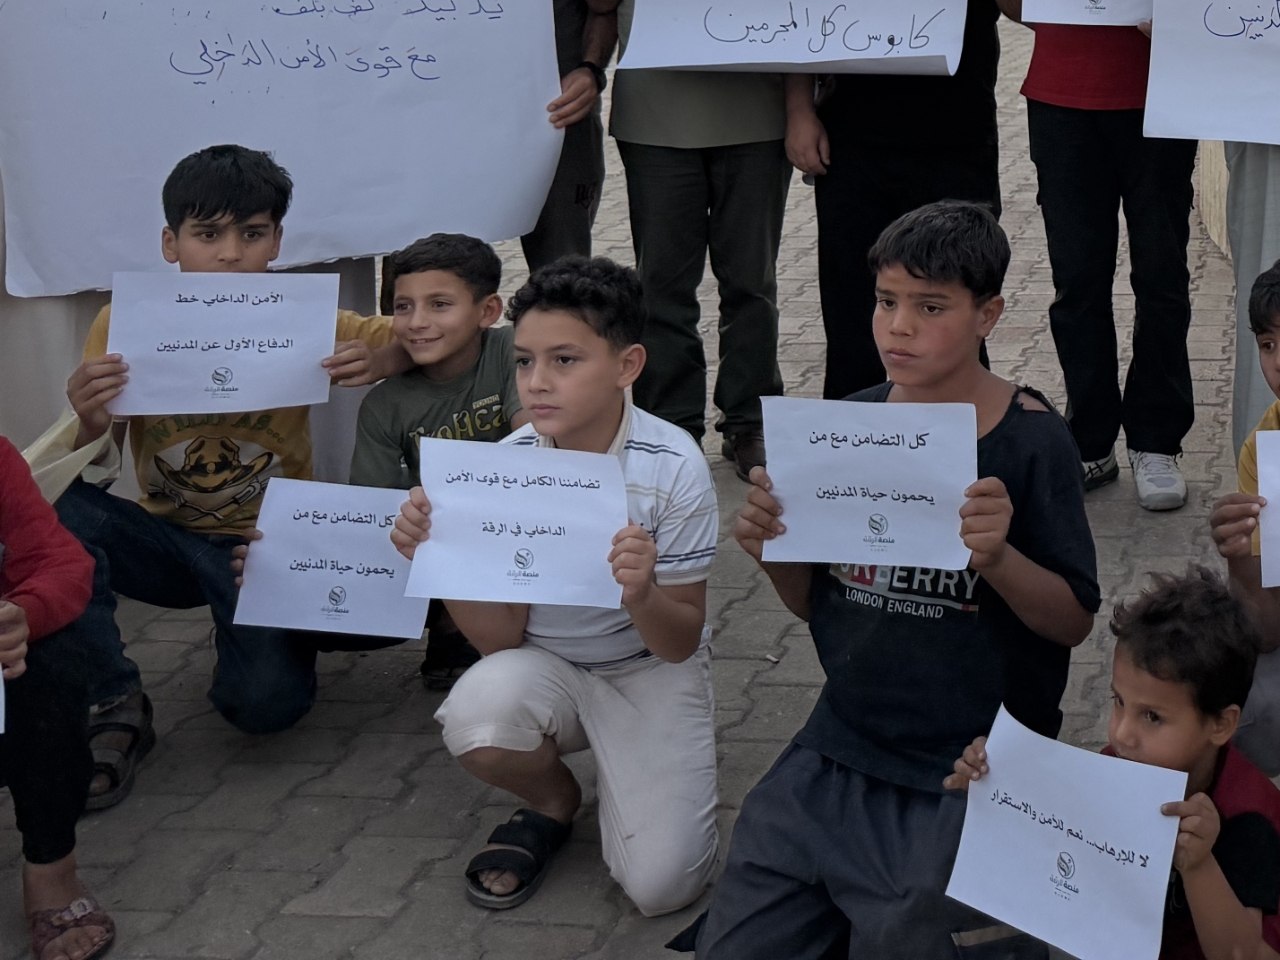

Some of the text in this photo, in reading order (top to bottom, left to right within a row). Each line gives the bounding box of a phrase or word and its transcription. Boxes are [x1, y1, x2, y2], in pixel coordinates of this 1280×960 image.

[704, 1, 946, 56] كابوس كل المجرمين
[175, 292, 283, 307] الأمن الداخلي خط
[156, 337, 294, 353] الدفاع الأول عن المدنيين
[809, 429, 929, 449] كل التضامن مع من
[445, 469, 600, 489] تضامننا الكامل مع قوى الأمن
[816, 485, 935, 505] يحمون حياة المدنيين
[293, 508, 396, 528] كل التضامن مع من
[482, 521, 566, 538] الداخلي في الرقة
[289, 558, 395, 579] يحمون حياة المدنيين
[846, 588, 944, 619] LONDON ENGLAND
[991, 788, 1036, 820] والاستقرار
[1039, 812, 1064, 831] للأمن
[1066, 829, 1083, 841] نعم
[1139, 855, 1149, 868] لا
